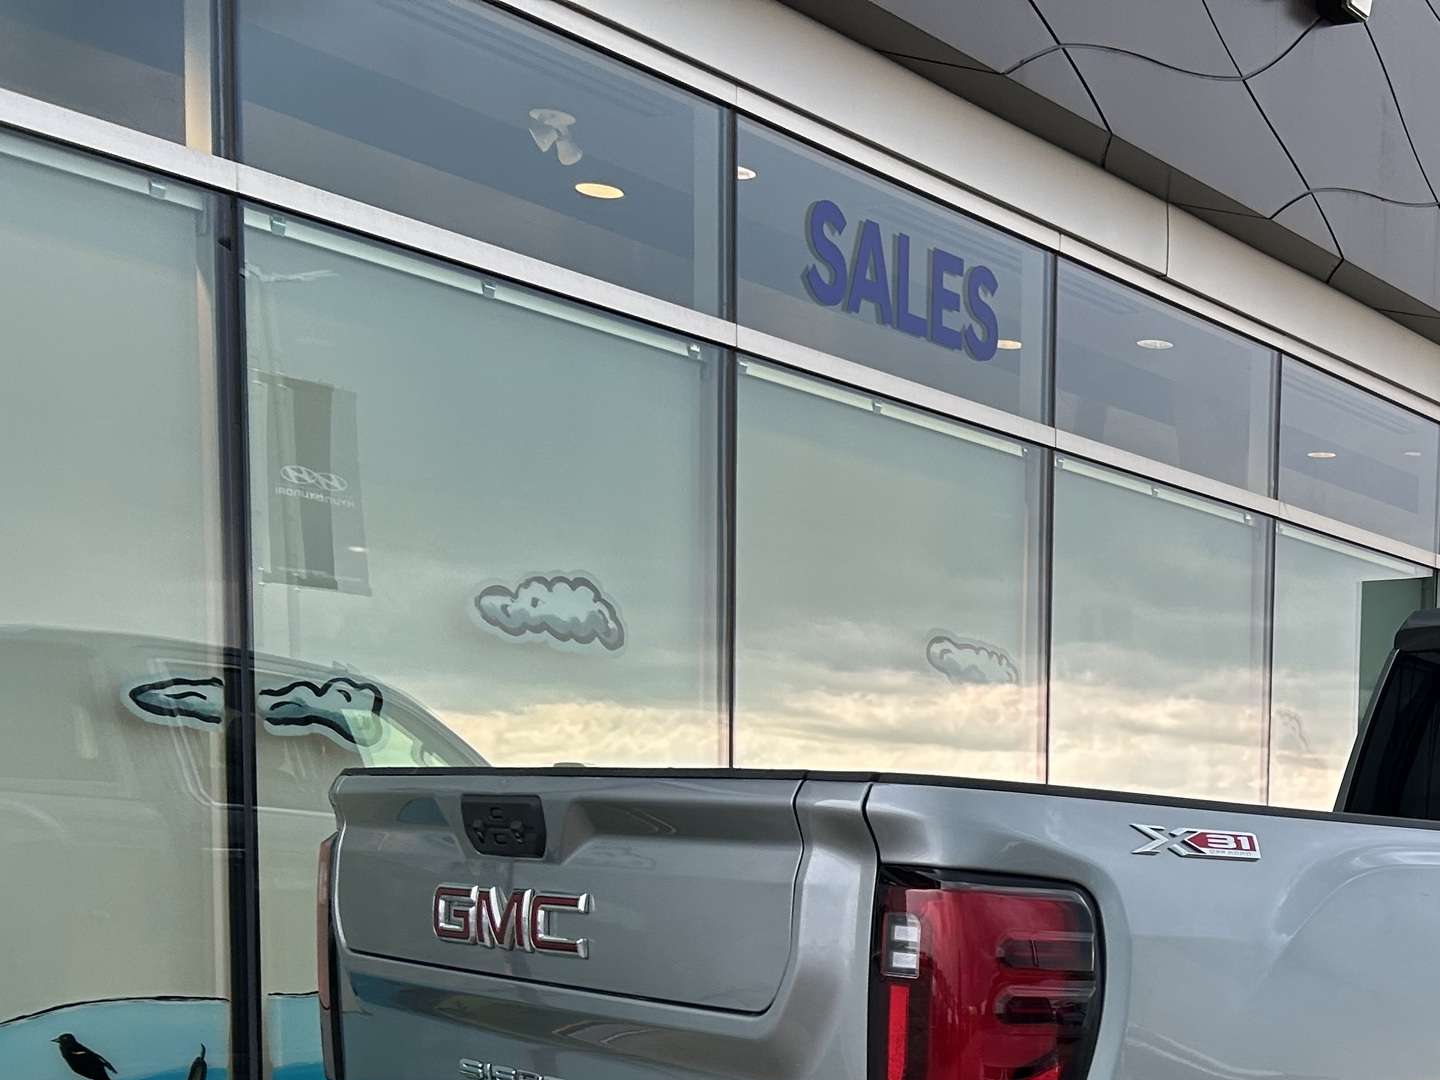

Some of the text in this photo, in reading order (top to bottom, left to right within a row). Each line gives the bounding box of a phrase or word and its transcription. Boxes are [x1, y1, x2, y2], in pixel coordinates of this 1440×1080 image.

[803, 200, 998, 361] SALES
[1129, 823, 1261, 861] X31
[432, 882, 594, 960] GMC
